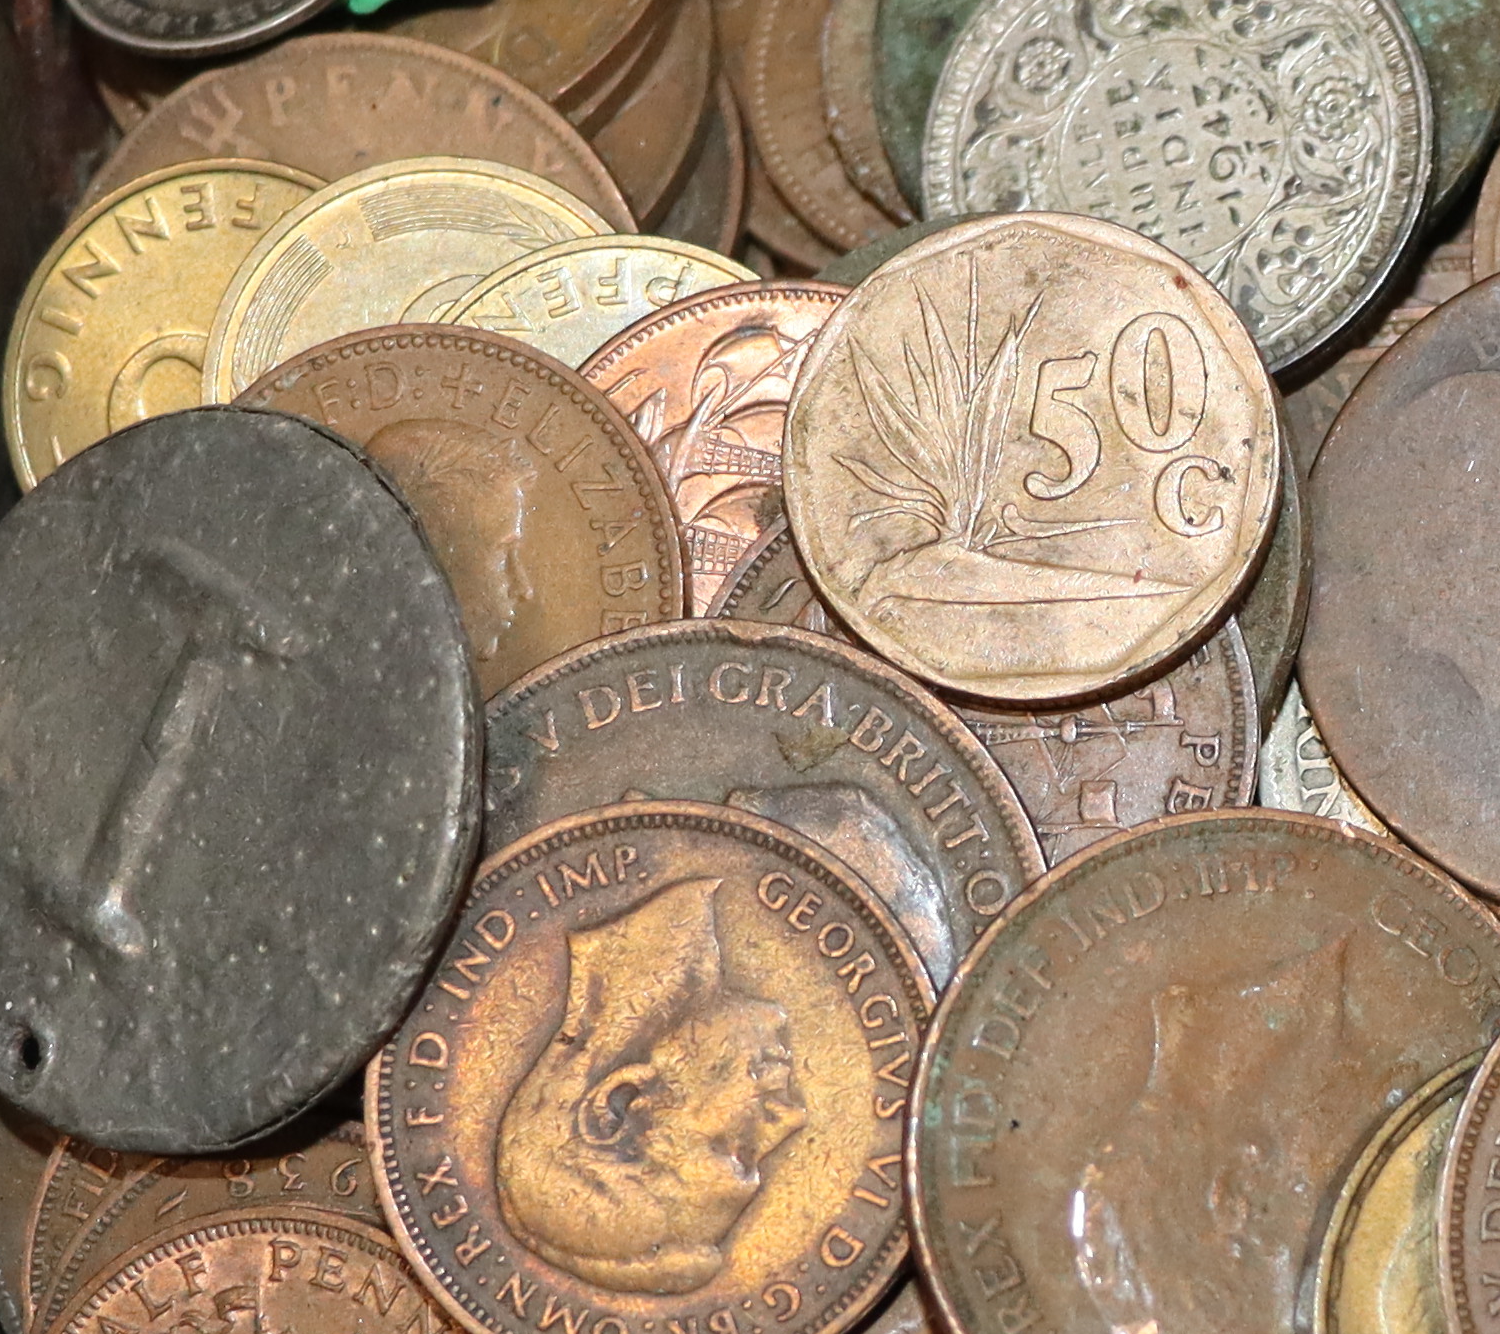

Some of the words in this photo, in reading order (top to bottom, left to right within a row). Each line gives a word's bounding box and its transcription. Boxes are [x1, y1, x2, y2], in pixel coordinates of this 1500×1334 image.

[25, 180, 275, 402] FENNIG
[1022, 311, 1208, 502] 50
[577, 664, 687, 732] DEI
[757, 871, 912, 1122] GEORGIVS
[223, 1150, 376, 1198] 938
[417, 1154, 493, 1268] REX
